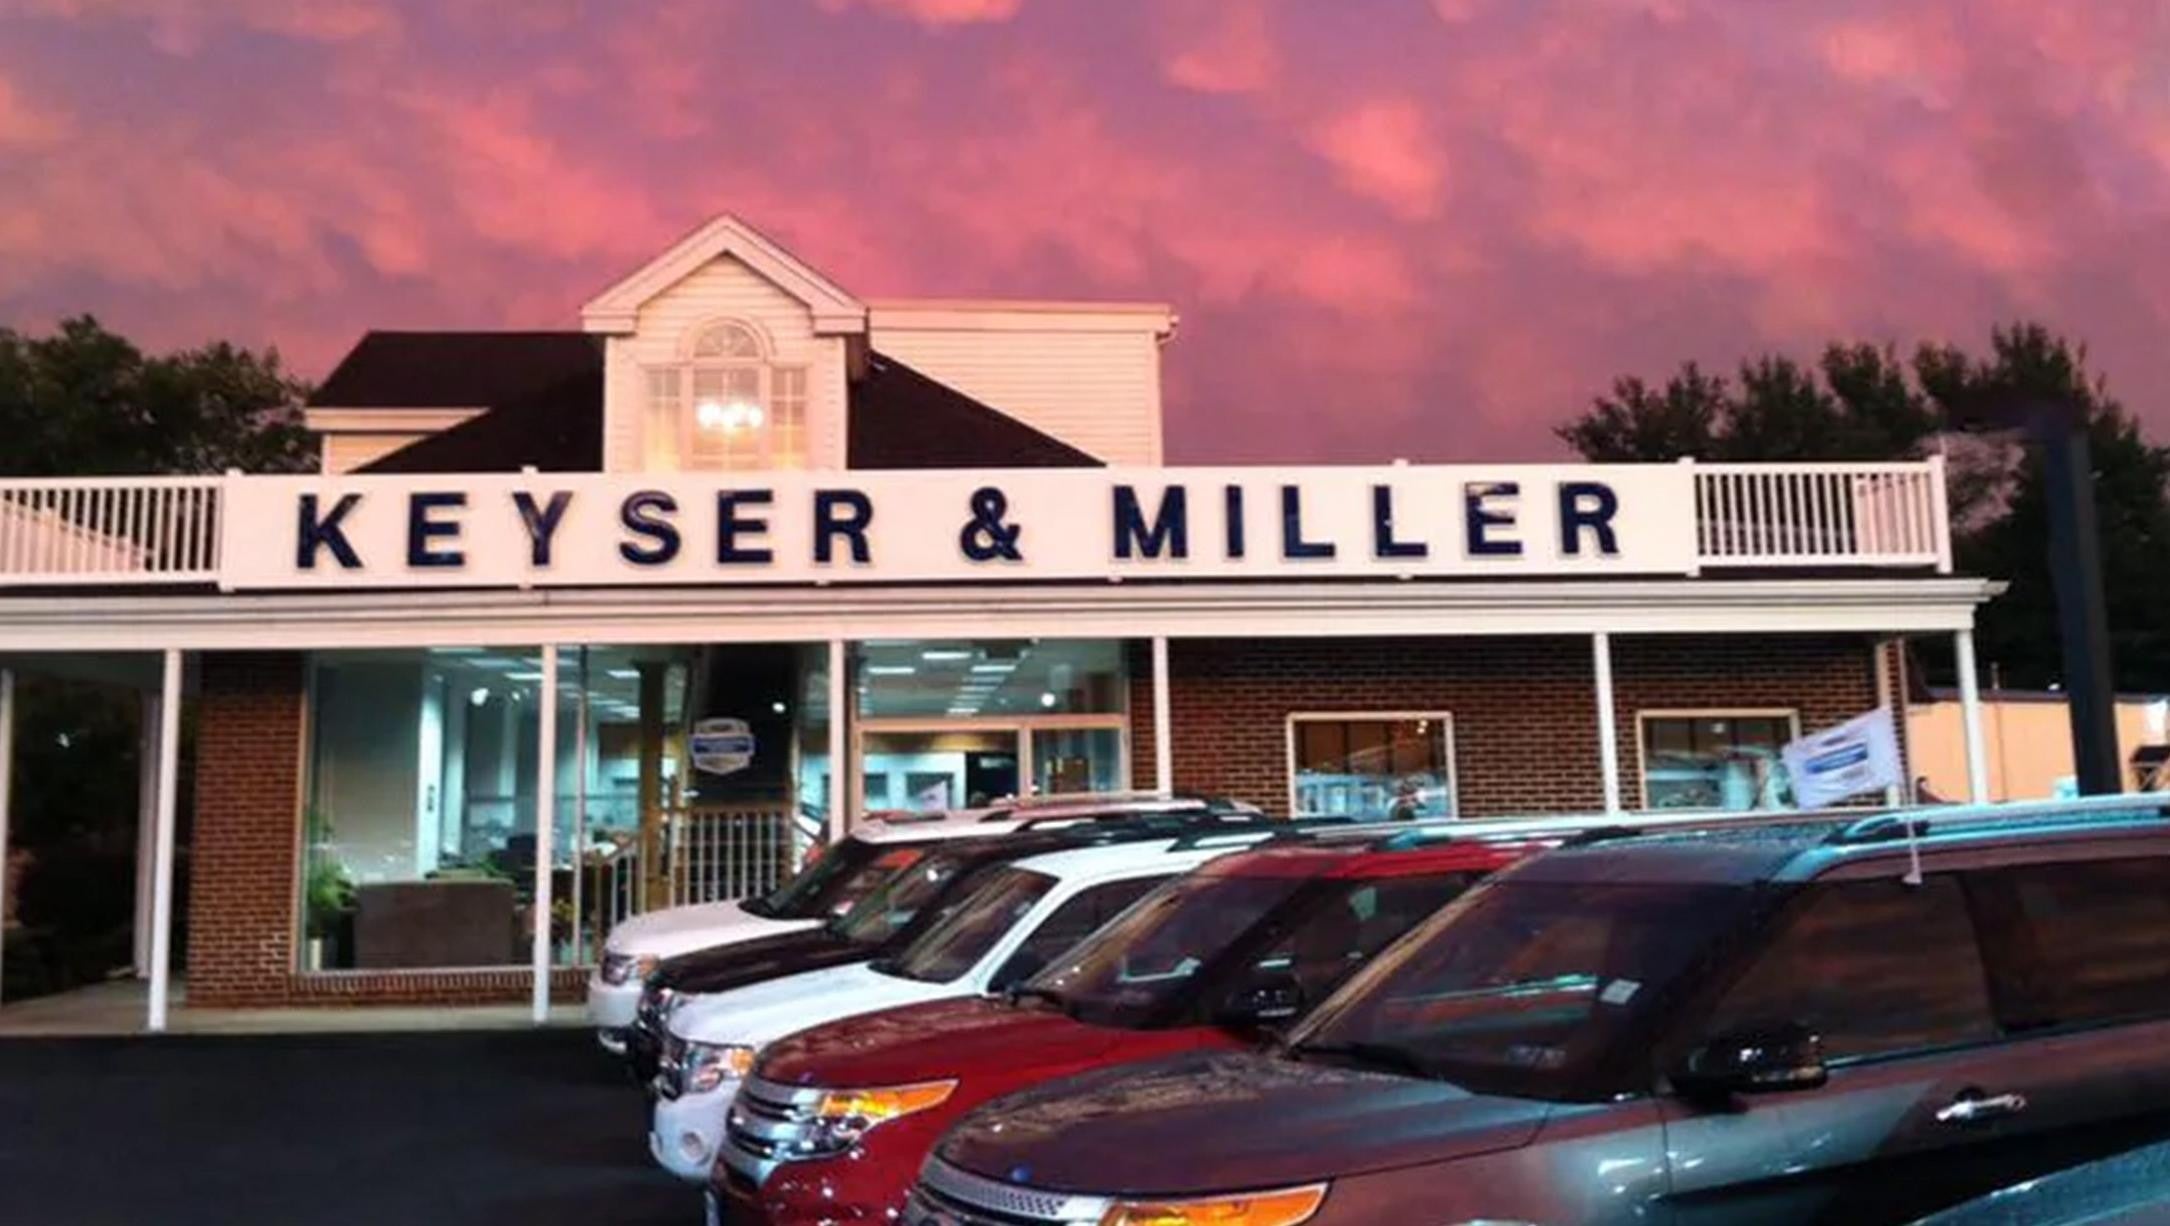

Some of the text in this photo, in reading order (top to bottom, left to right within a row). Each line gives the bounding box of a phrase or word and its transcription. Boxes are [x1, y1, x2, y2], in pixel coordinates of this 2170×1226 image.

[297, 481, 1620, 569] KEYSER & MILLER
